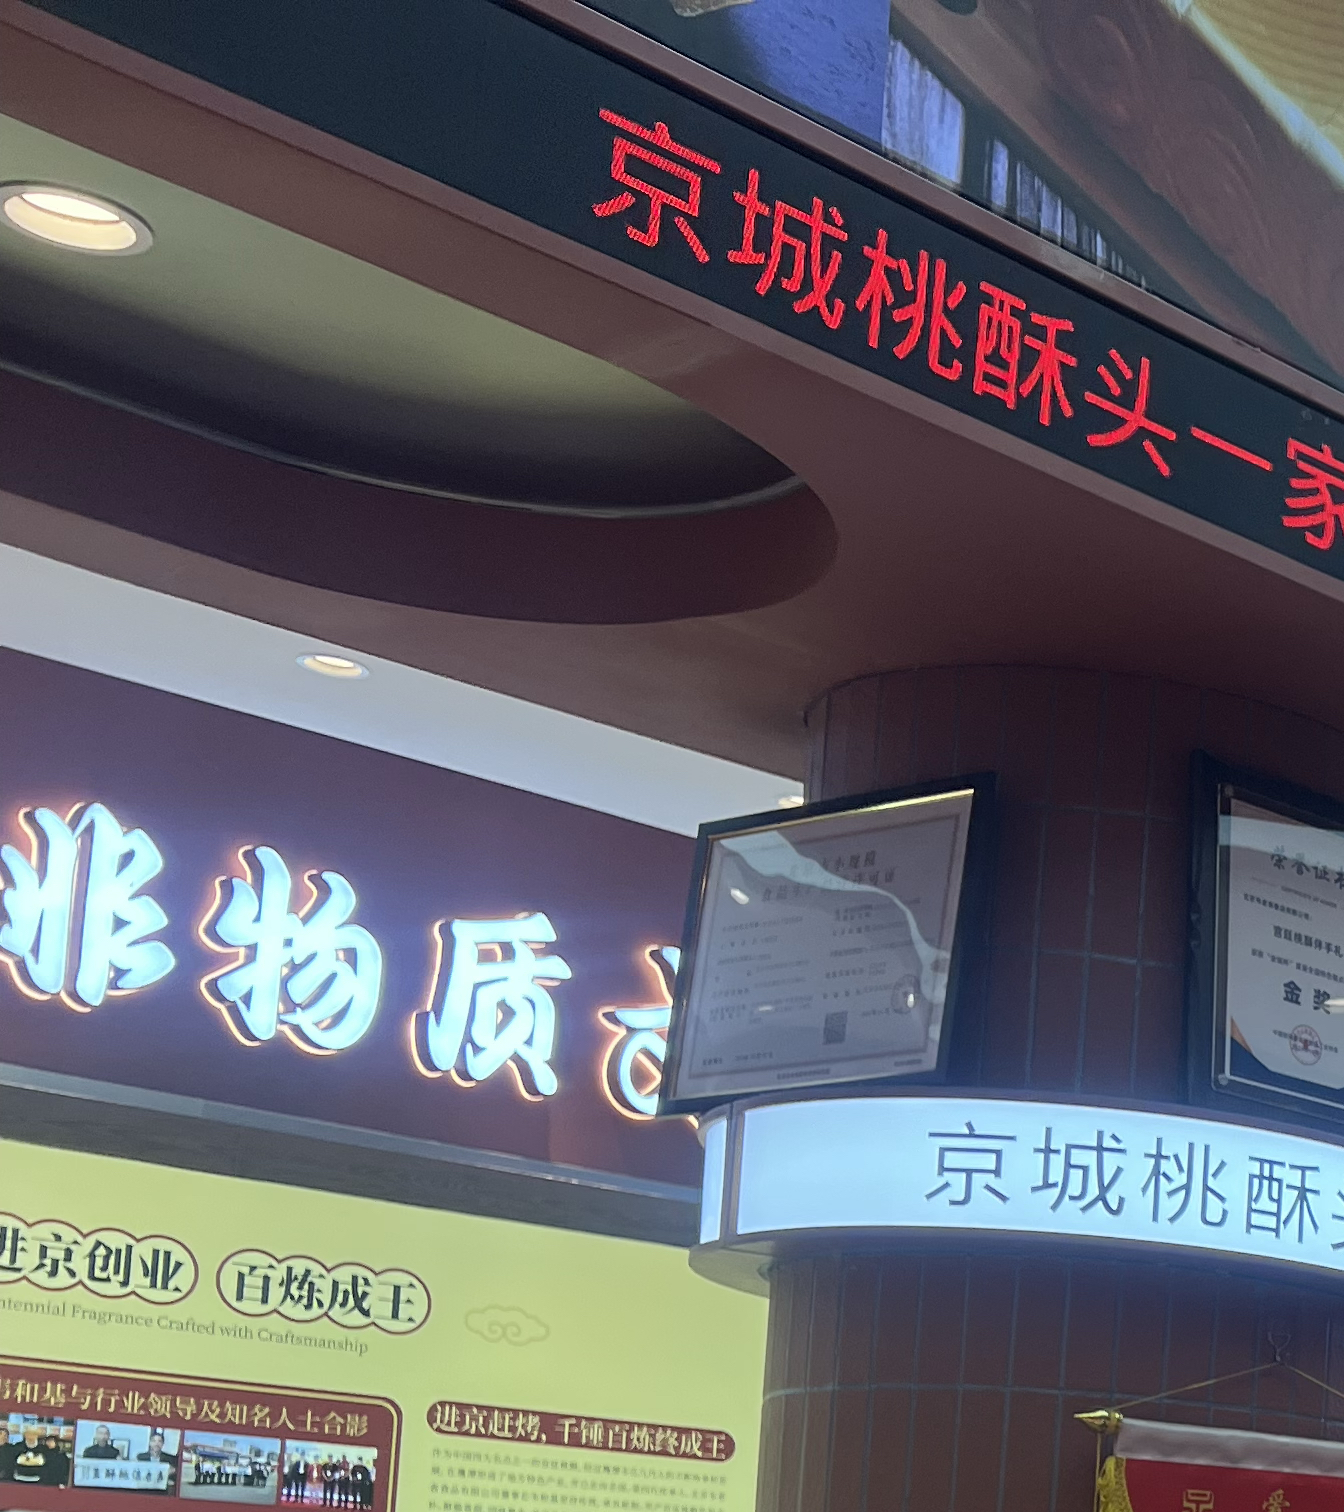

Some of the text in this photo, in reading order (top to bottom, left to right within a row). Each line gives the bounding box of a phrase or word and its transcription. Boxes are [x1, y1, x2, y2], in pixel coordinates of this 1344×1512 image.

[231, 1258, 418, 1327] 百炼成王
[71, 1304, 153, 1328] Fragrance
[156, 1314, 216, 1337] Crafted
[219, 1324, 254, 1341] with
[257, 1327, 369, 1357] Craftsmanship
